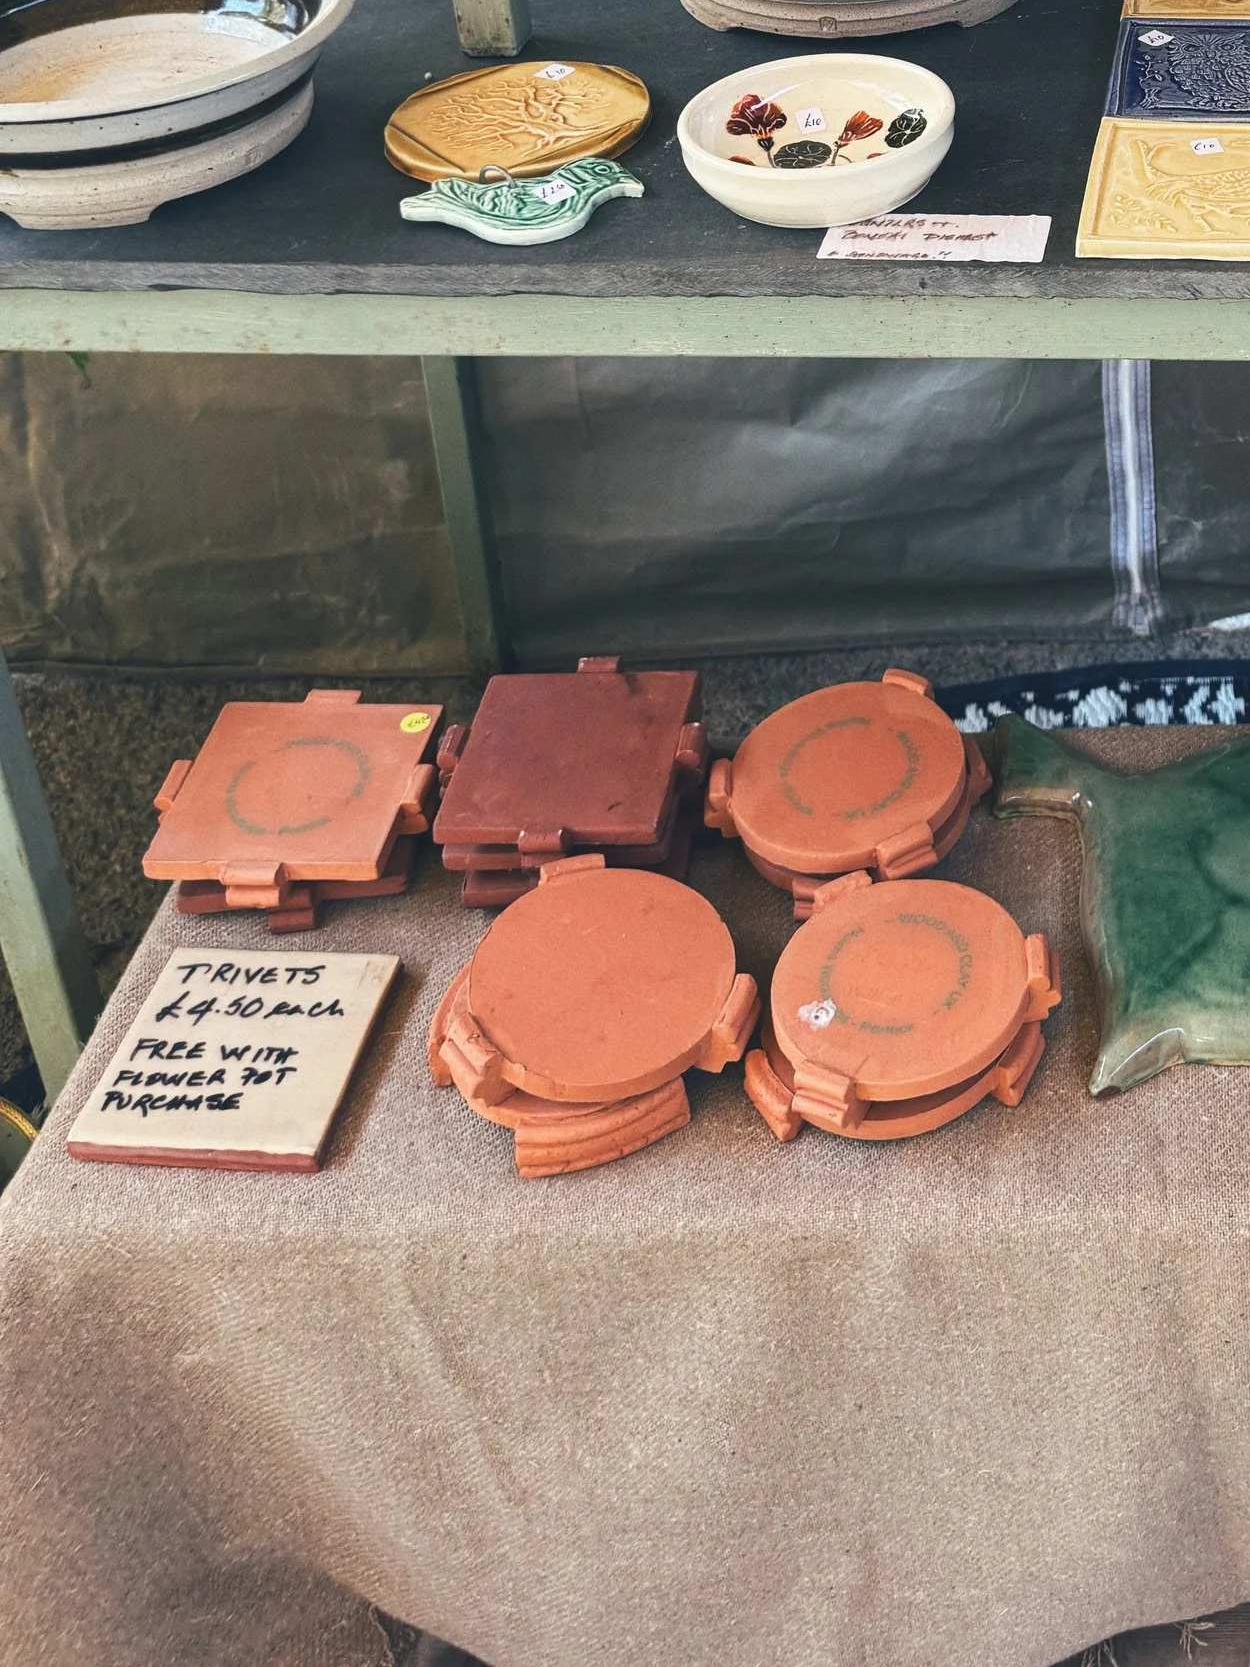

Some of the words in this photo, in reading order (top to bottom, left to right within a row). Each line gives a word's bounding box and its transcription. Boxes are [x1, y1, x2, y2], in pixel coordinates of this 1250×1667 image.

[176, 962, 327, 985] TRIVETS
[155, 990, 264, 1026] £4.50
[263, 998, 345, 1021] each
[129, 1037, 207, 1062] FREE
[219, 1043, 300, 1065] WITH
[112, 1068, 225, 1087] FLOWER
[240, 1066, 298, 1087] POT
[100, 1089, 245, 1118] PURCHASE
